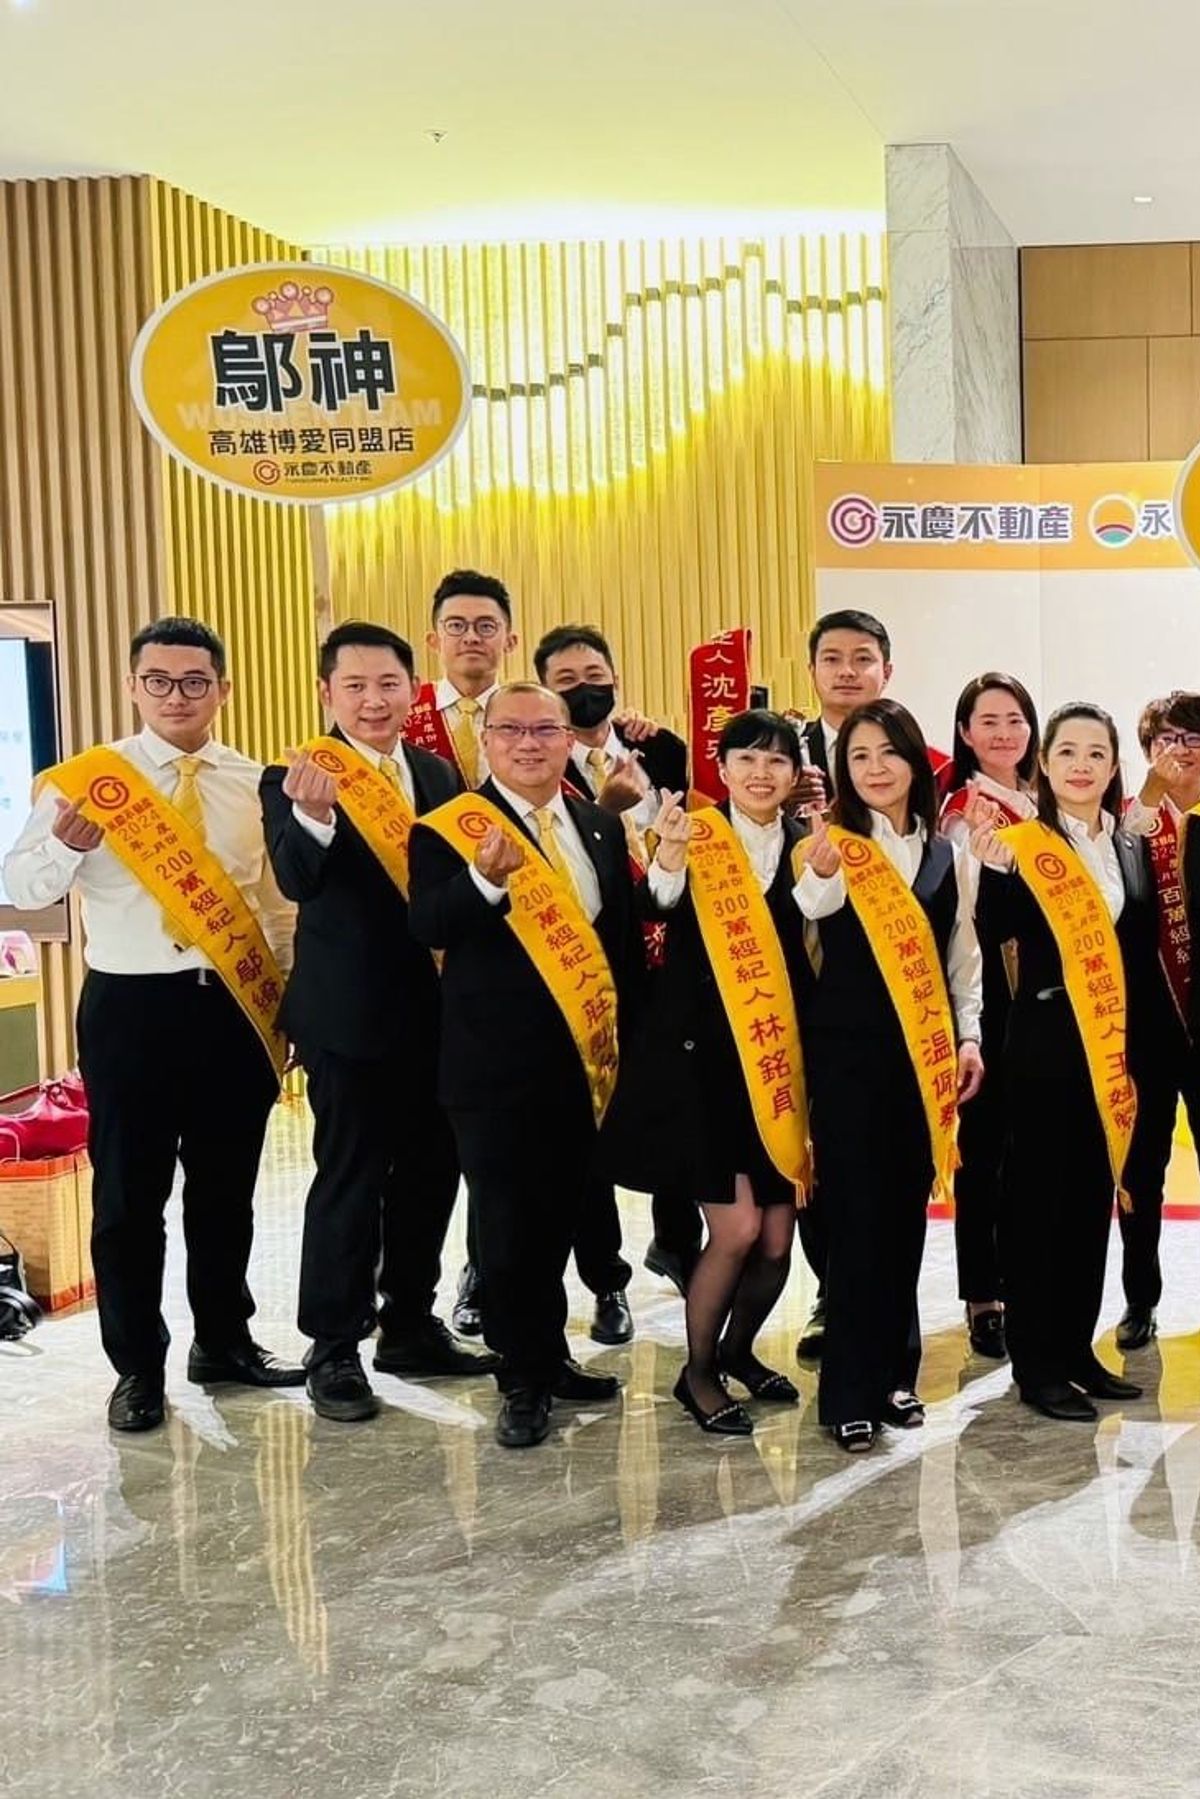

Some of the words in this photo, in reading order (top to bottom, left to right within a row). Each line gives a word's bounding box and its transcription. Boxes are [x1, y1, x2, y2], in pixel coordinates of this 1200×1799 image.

[211, 330, 396, 412] 鄔神
[208, 427, 414, 456] 高雄博愛同盟店
[882, 505, 1069, 541] 永慶不動產
